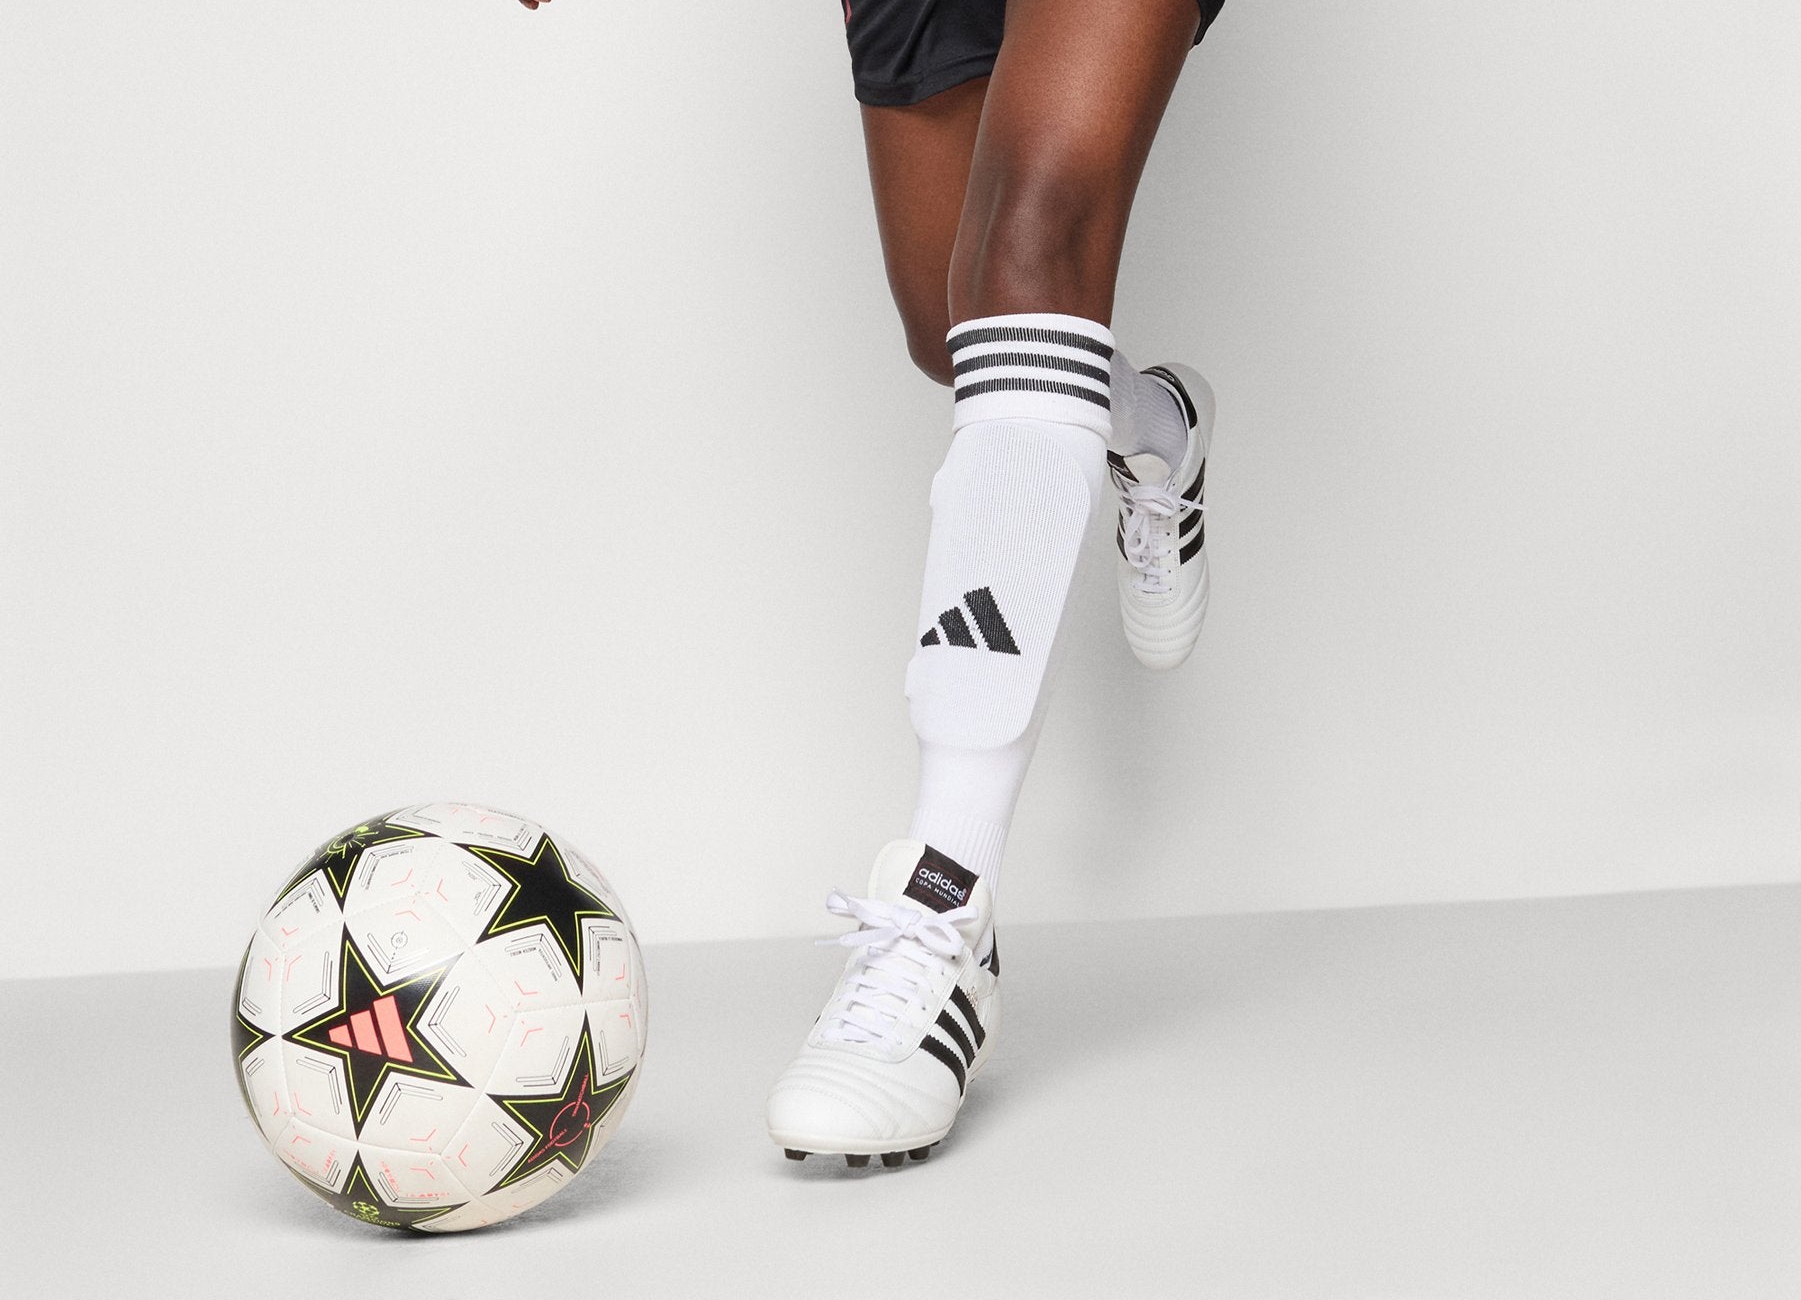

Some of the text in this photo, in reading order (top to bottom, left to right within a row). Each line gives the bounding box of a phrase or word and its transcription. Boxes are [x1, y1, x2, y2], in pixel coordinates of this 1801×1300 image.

[915, 878, 960, 907] COPA MUNDIAL
[918, 868, 966, 901] adidas
